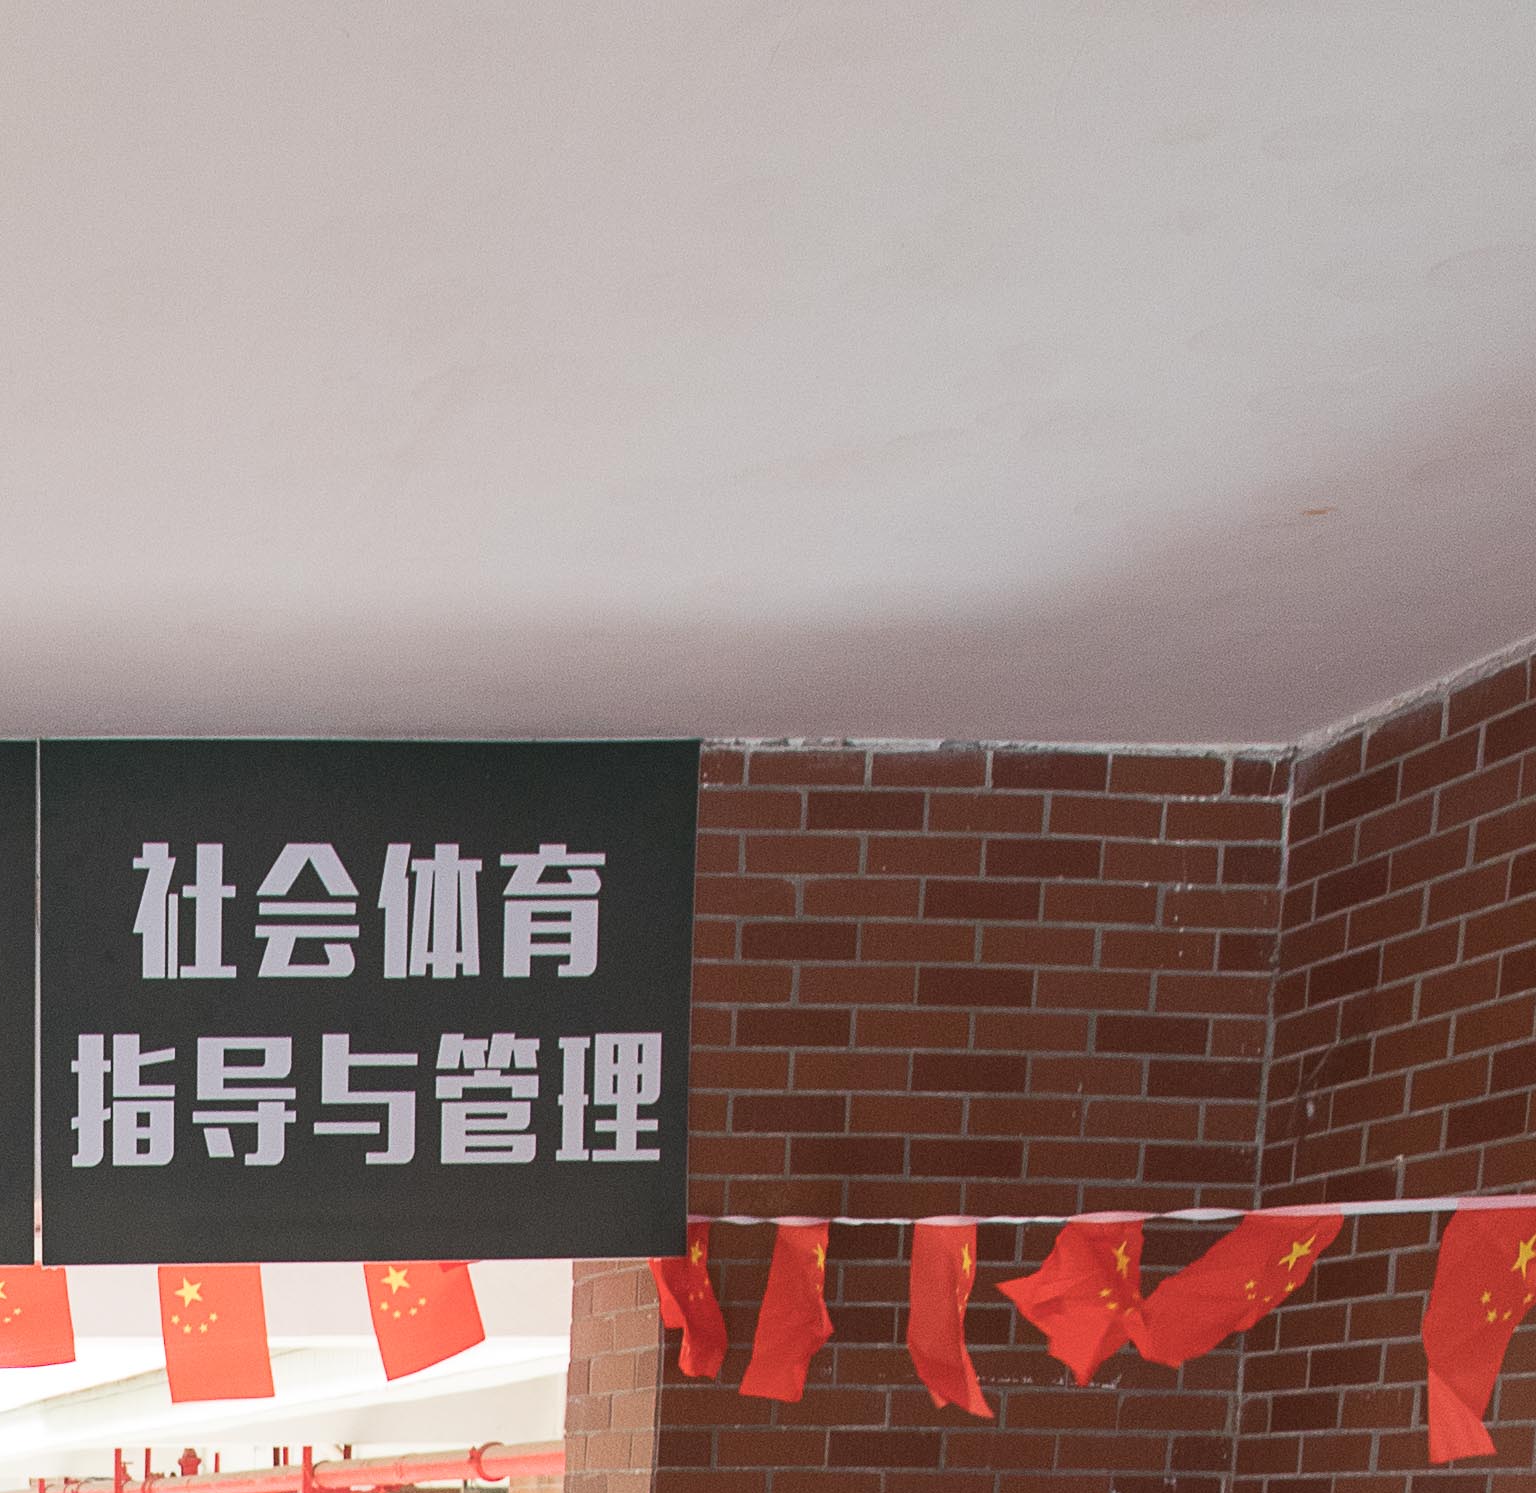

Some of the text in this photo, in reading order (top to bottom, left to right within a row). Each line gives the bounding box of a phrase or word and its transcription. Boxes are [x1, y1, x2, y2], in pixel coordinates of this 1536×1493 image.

[132, 842, 606, 980] 社会体育
[71, 1033, 663, 1168] 指导与管理
